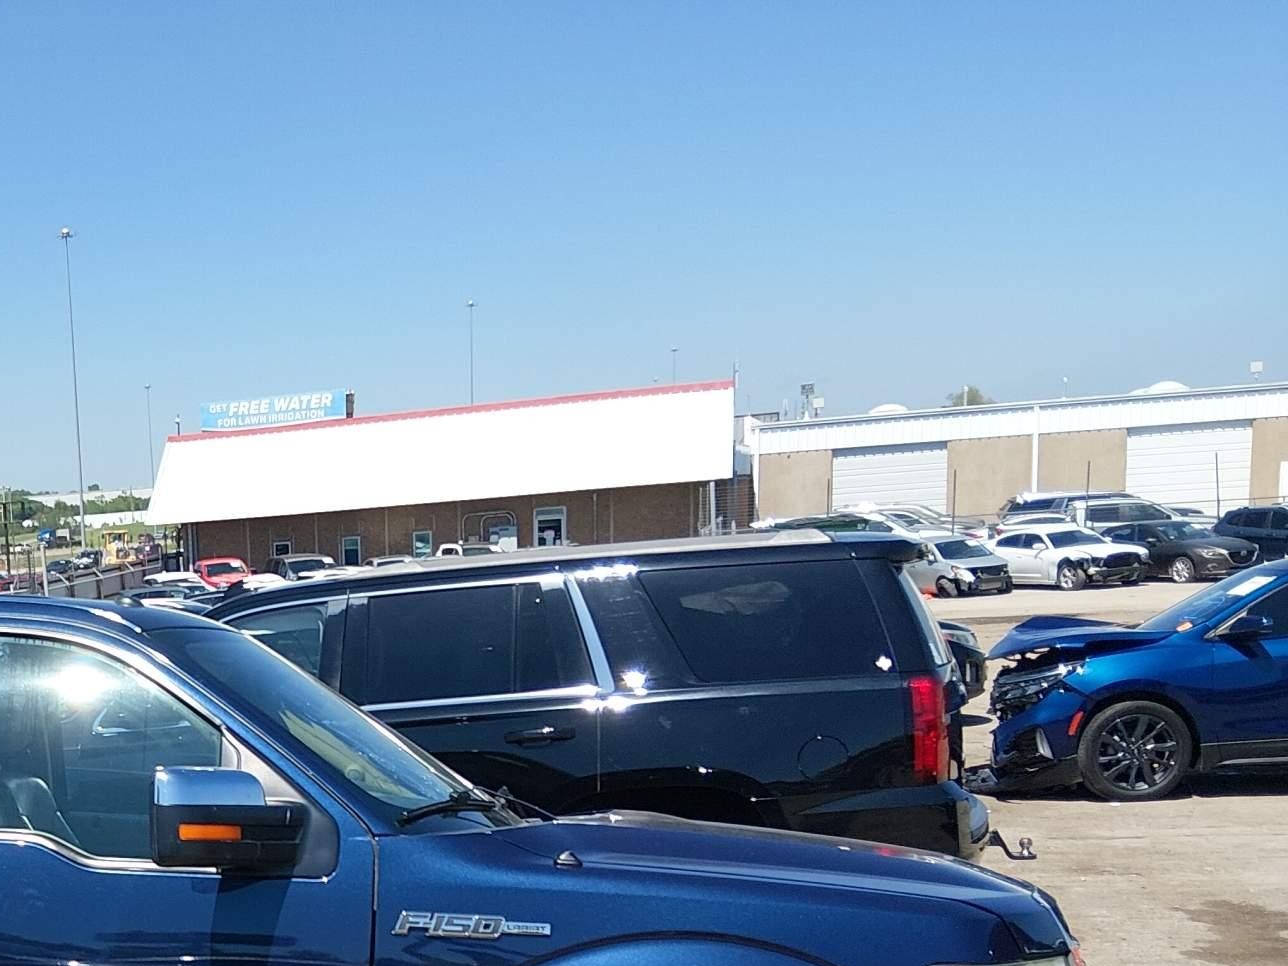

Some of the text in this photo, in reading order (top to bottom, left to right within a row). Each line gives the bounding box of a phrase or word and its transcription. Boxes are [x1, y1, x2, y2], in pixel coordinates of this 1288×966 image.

[209, 393, 333, 417] GET FREE WATER
[217, 409, 325, 428] FOR LAWN IRRIGATION
